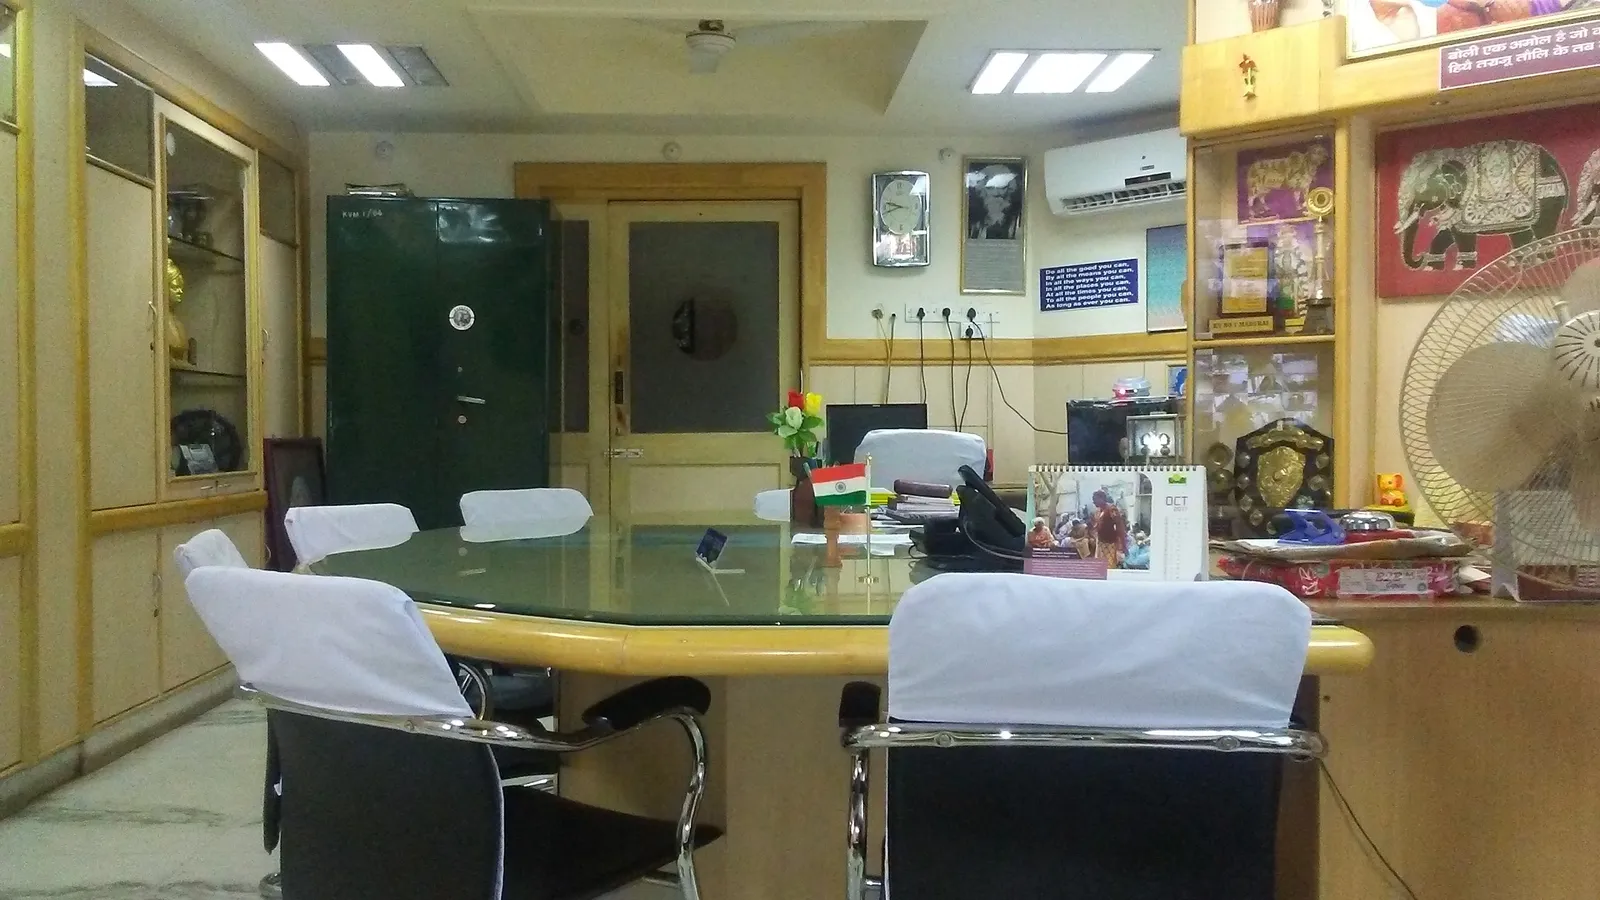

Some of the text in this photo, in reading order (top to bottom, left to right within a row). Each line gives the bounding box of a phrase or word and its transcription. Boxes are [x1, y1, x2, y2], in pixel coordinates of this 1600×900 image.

[1447, 44, 1480, 60] बोली
[1482, 42, 1507, 56] एक
[1509, 34, 1552, 50] अमोल
[1555, 29, 1567, 43] है
[1569, 26, 1589, 39] जो
[1552, 44, 1570, 56] के
[1571, 42, 1595, 53] तब
[1078, 264, 1098, 272] good
[1165, 495, 1189, 507] OCT
